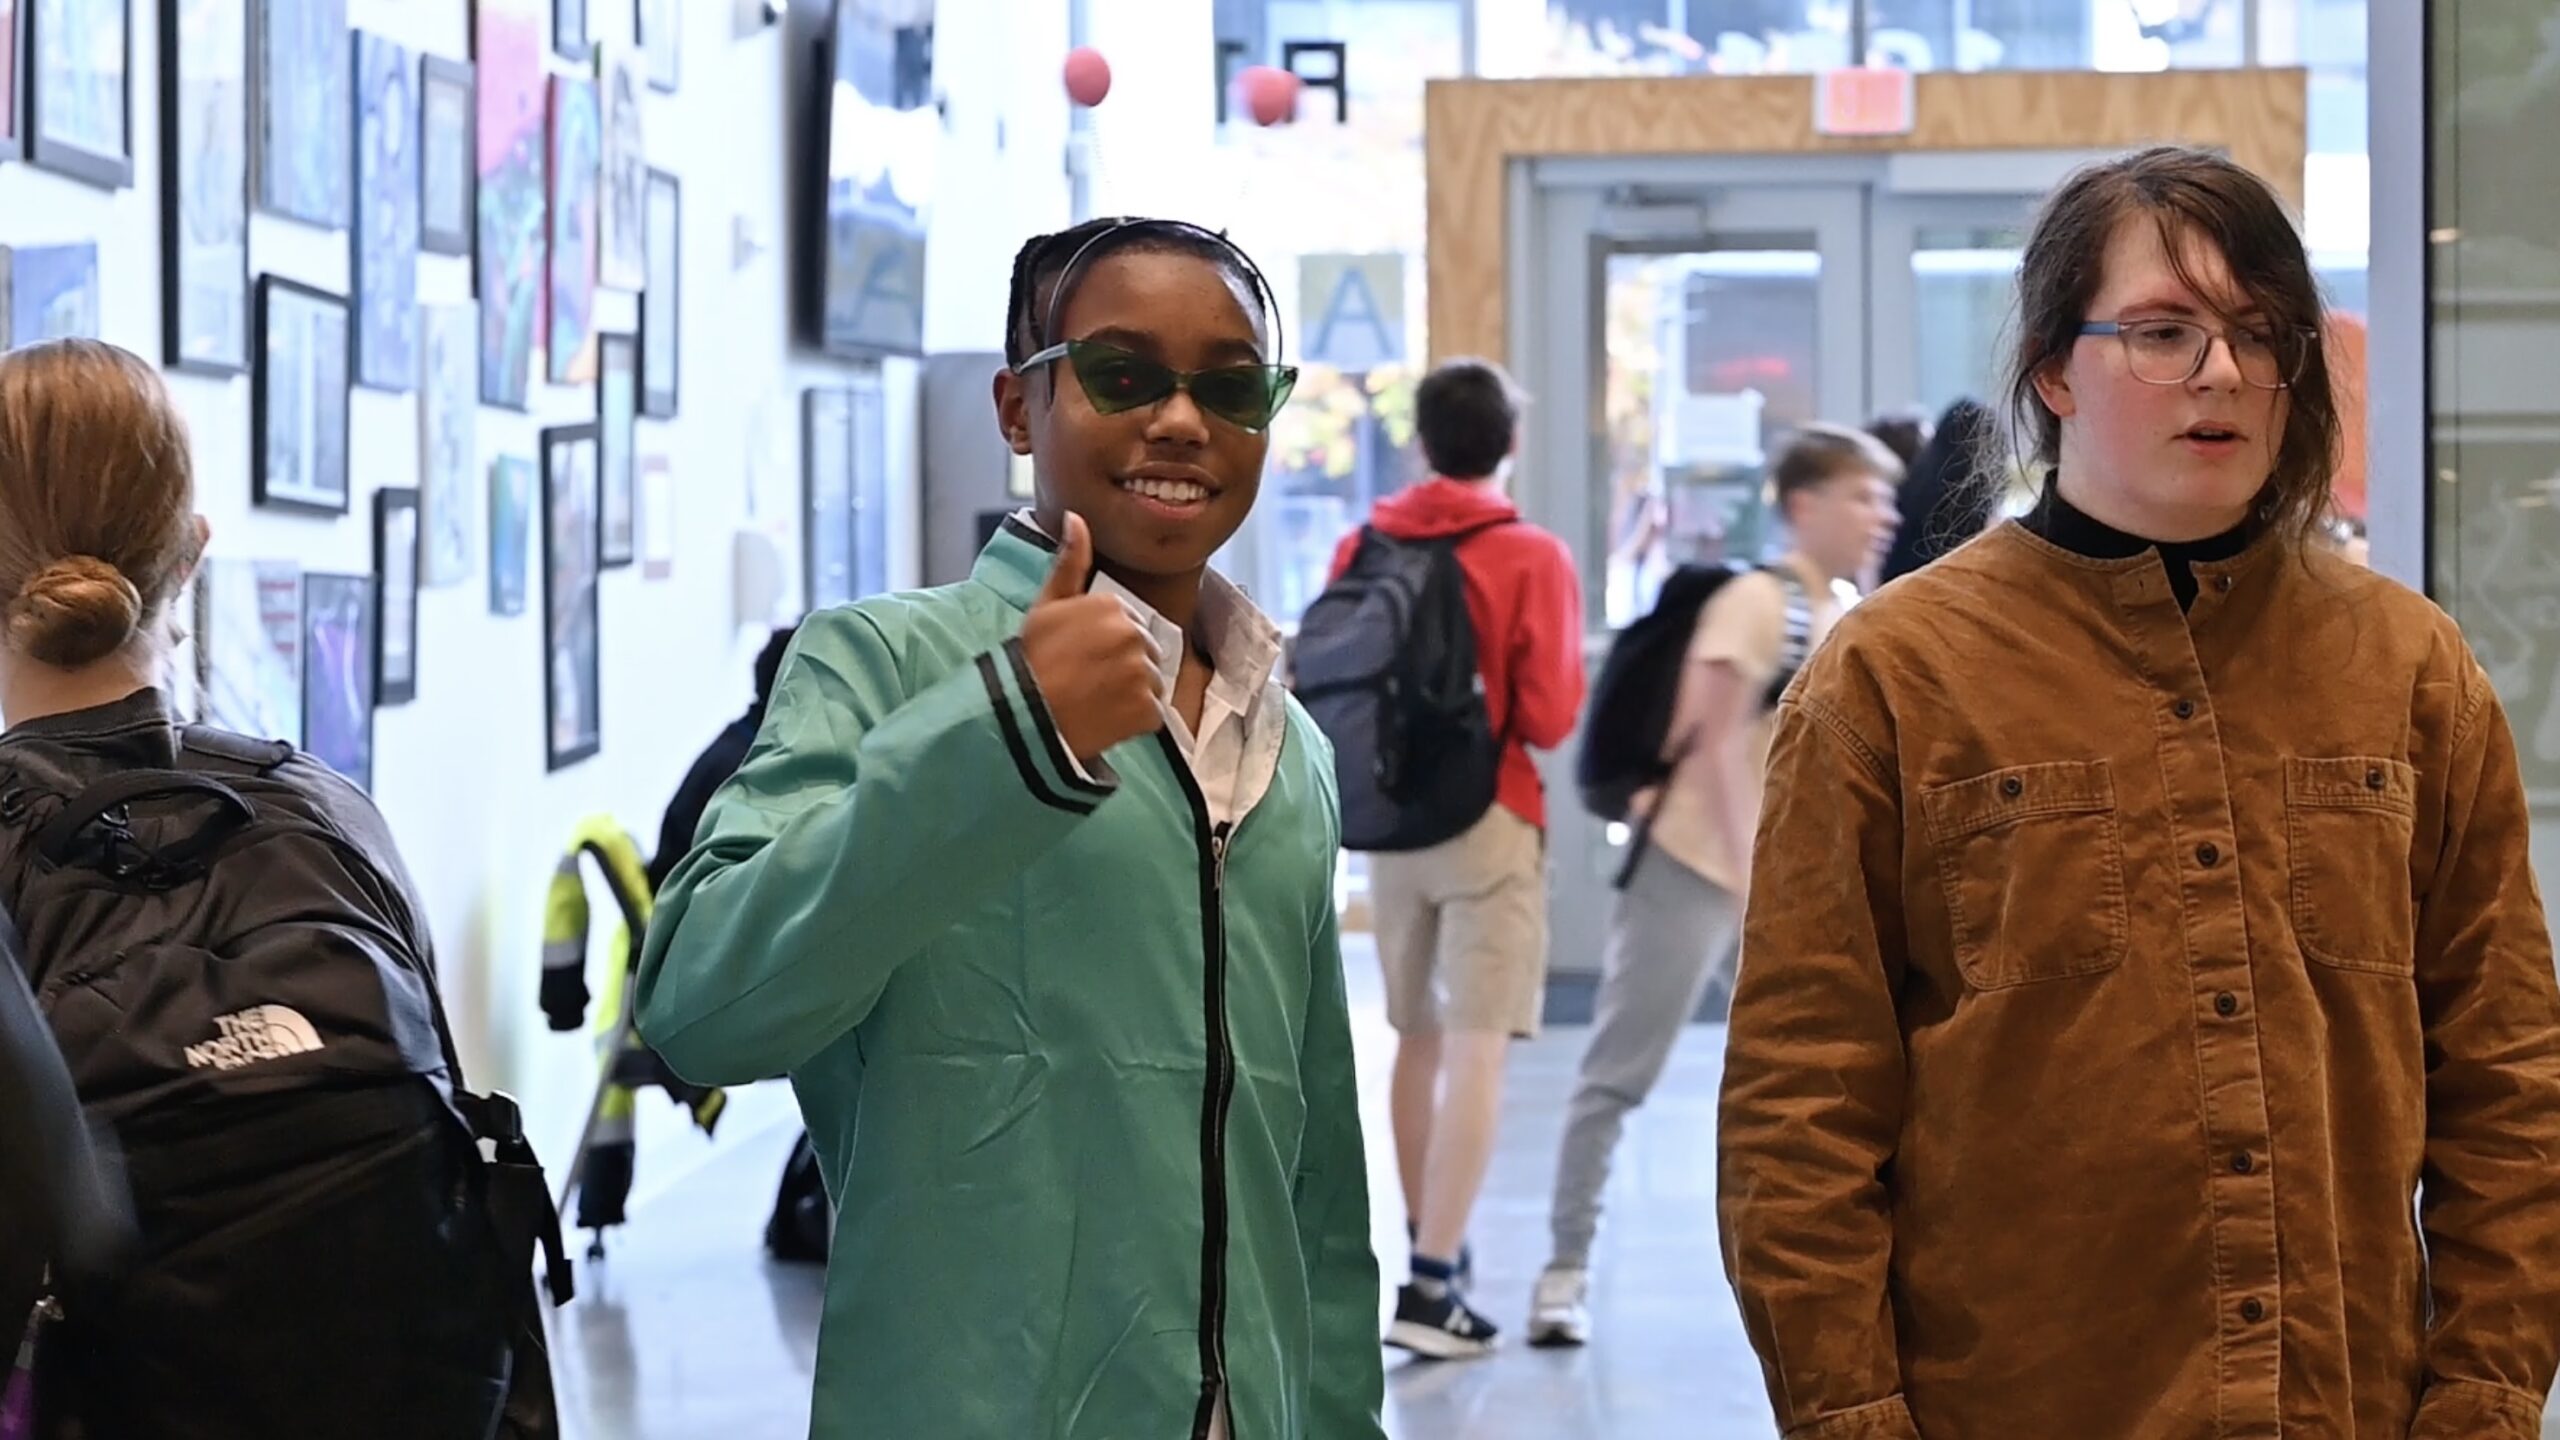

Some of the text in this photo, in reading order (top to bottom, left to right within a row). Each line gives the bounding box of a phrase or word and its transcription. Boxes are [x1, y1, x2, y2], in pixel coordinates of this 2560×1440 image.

[1311, 265, 1395, 358] A
[212, 1006, 267, 1036] THE
[182, 1027, 275, 1068] NORTH
